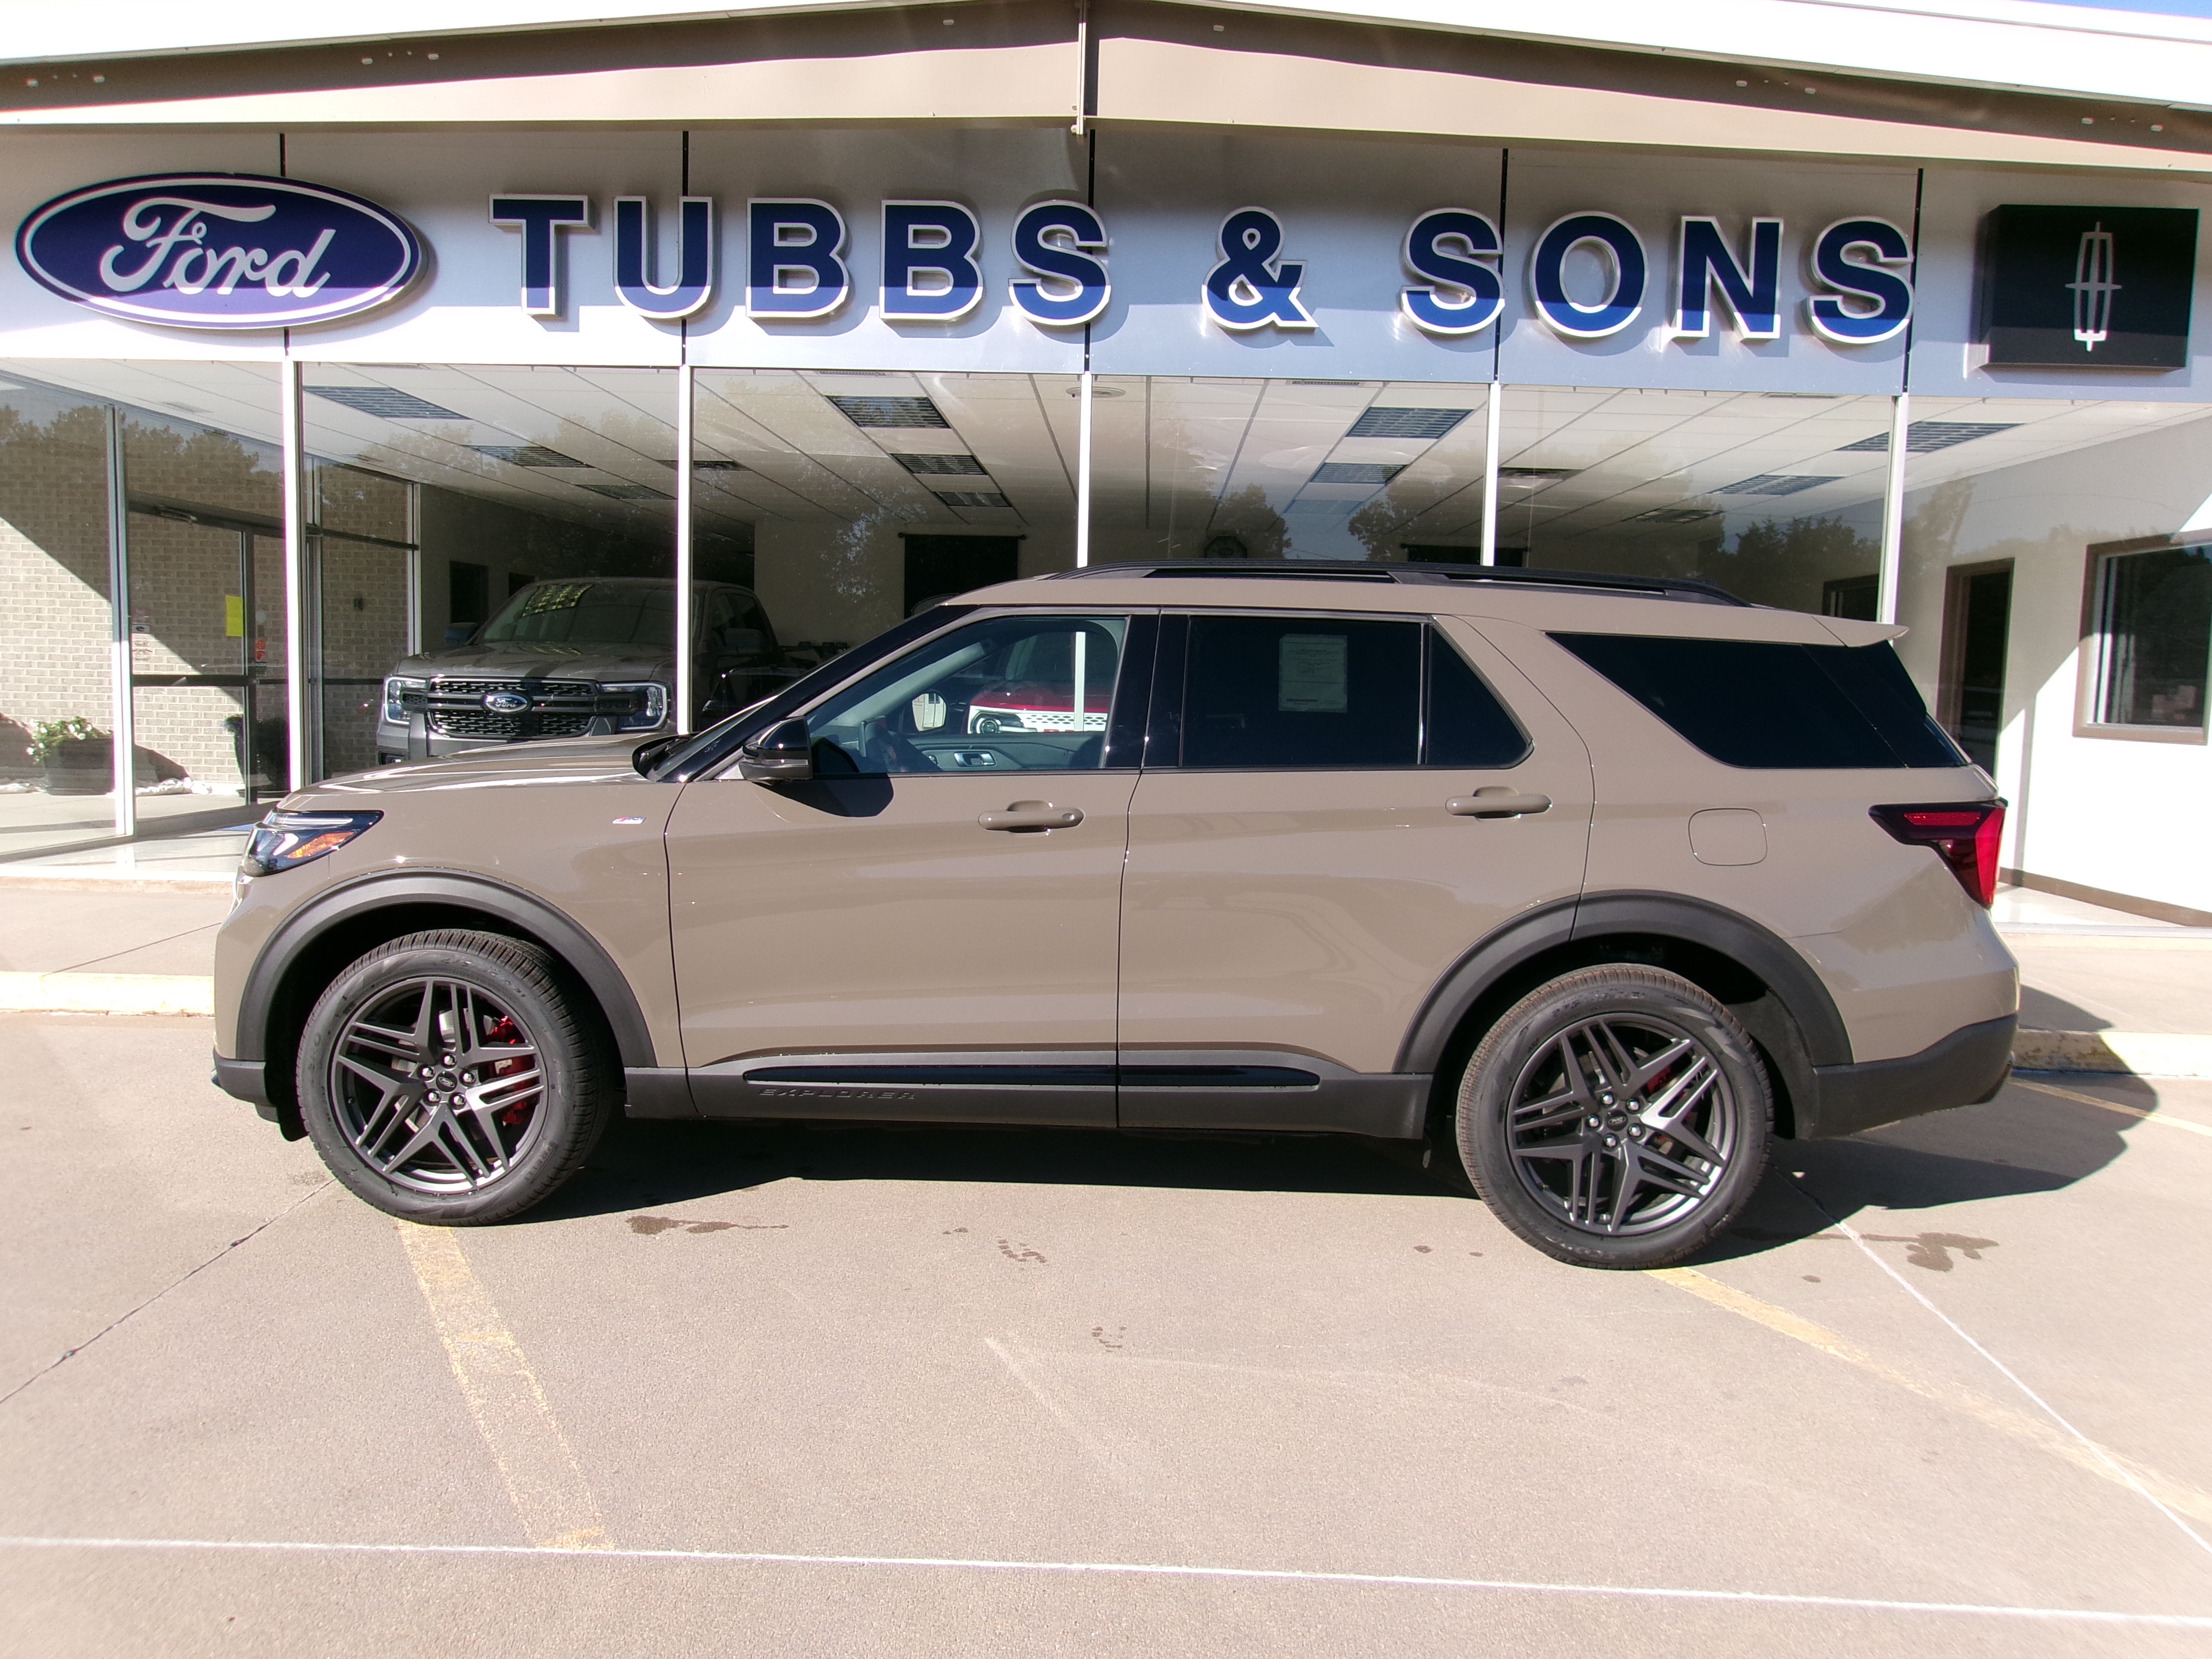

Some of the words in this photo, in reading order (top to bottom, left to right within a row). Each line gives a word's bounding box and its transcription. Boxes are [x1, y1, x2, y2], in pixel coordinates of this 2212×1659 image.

[99, 197, 337, 298] Ford
[488, 195, 1111, 326] TUBBS
[1201, 206, 1318, 333] &
[1401, 207, 1914, 345] SONS
[495, 697, 518, 708] Ford
[759, 1088, 914, 1099] EXPLORER
